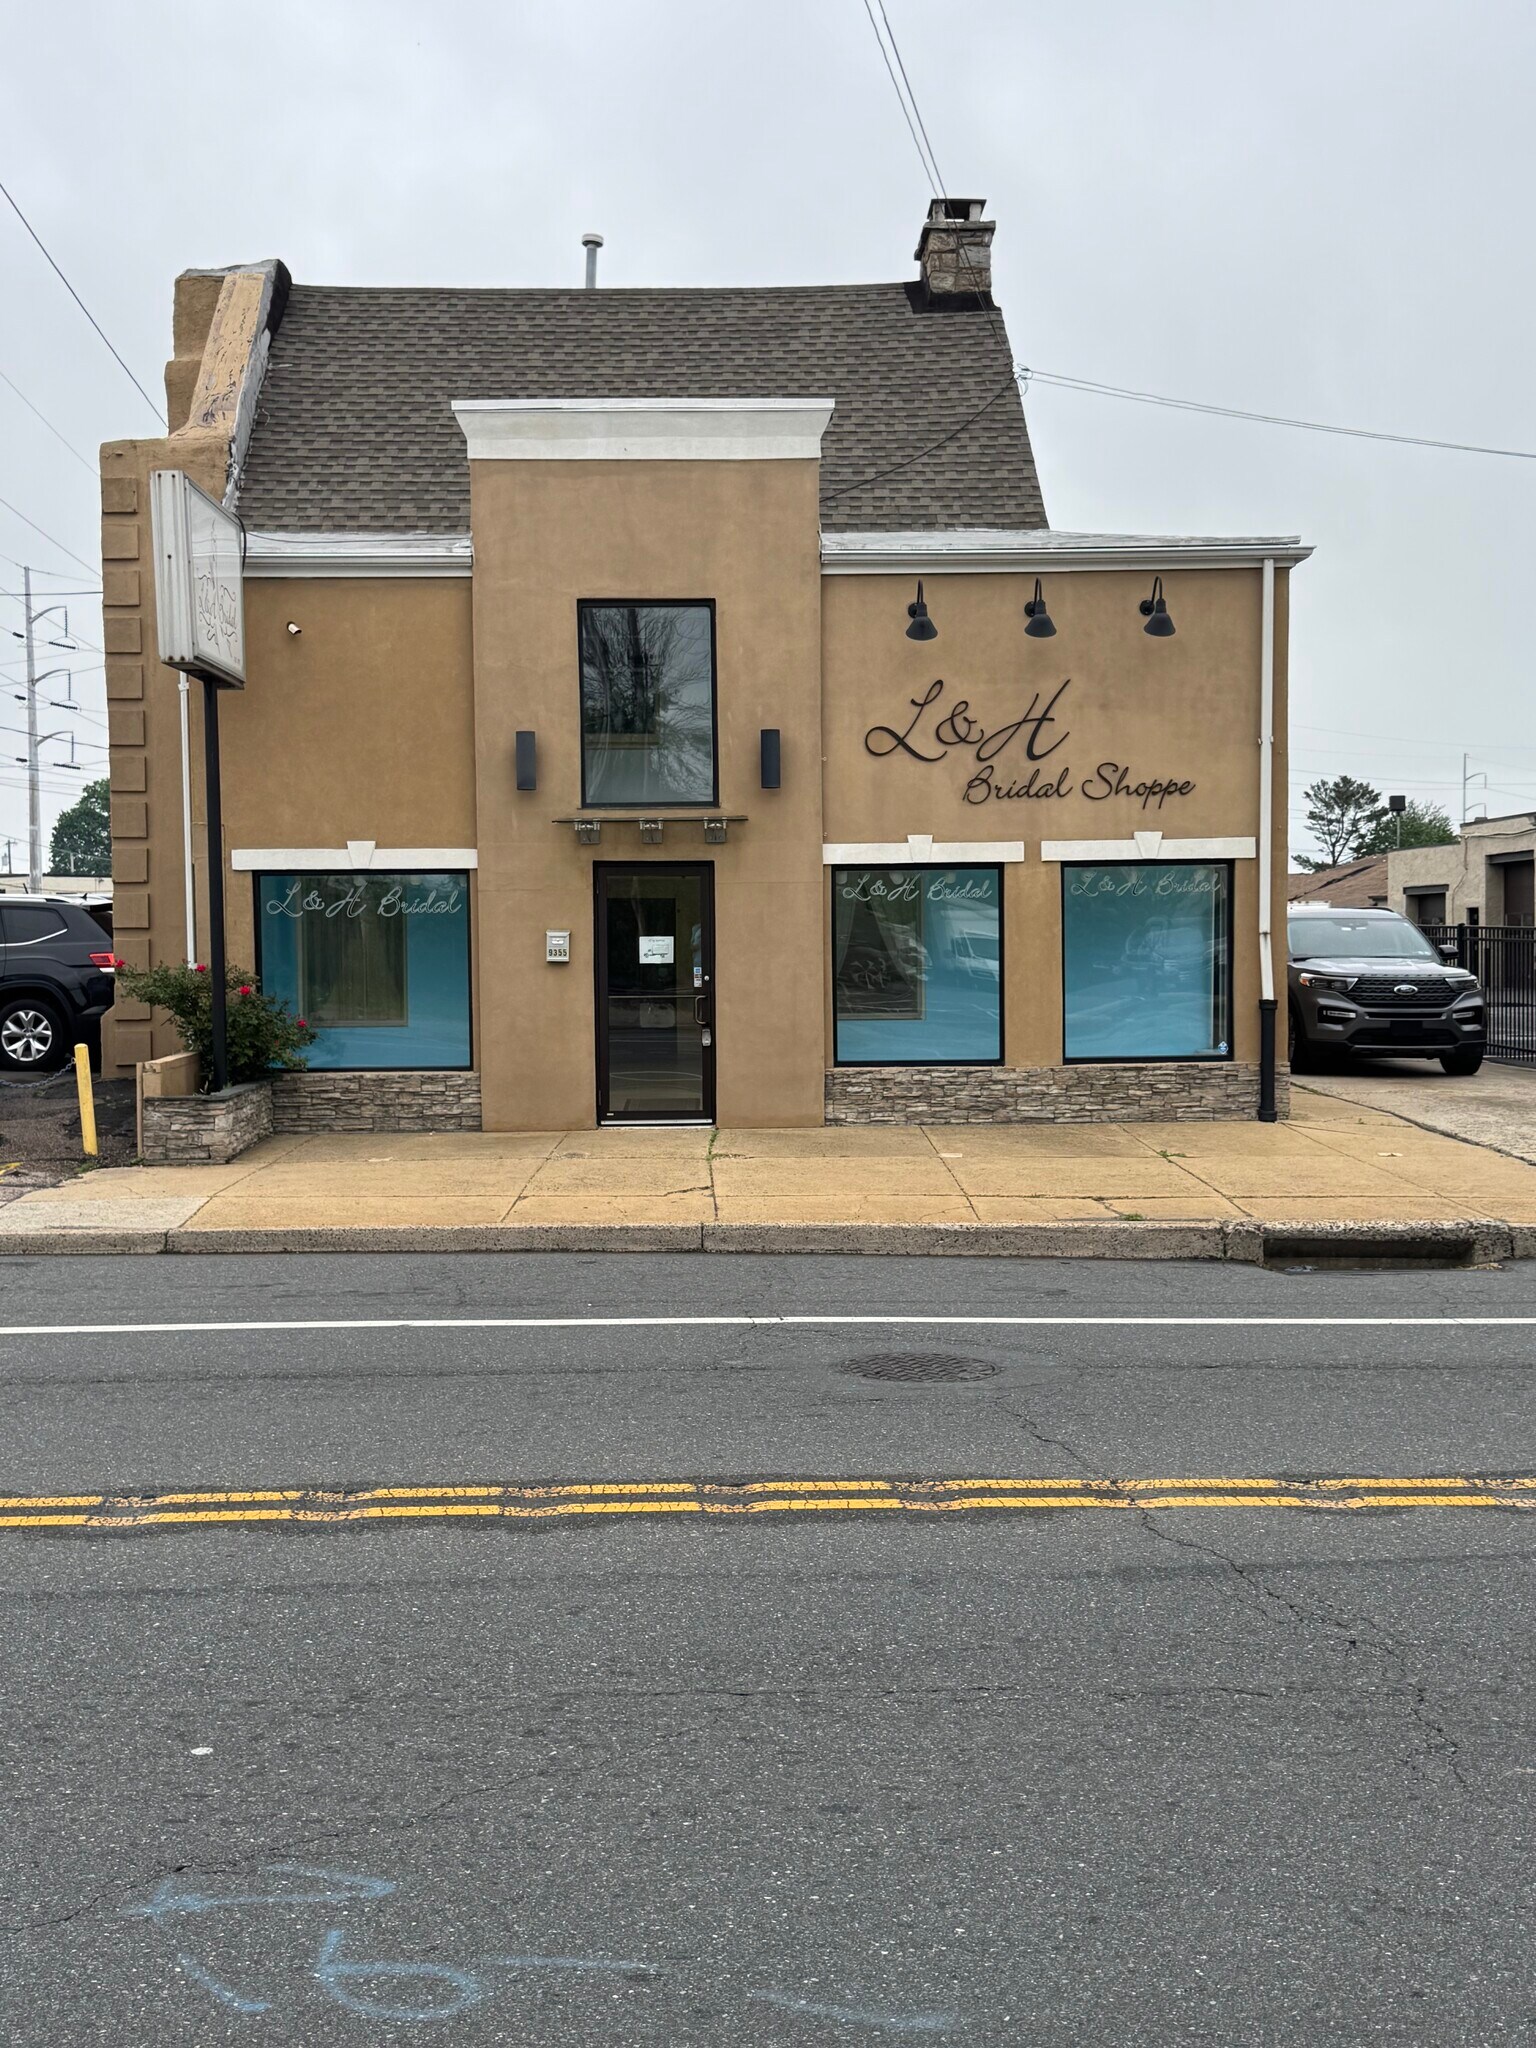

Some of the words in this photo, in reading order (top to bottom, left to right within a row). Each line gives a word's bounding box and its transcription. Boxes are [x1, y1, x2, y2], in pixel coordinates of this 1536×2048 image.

[962, 765, 1074, 804] Bridal
[1082, 762, 1197, 810] Shoppe
[927, 877, 992, 901] Bridal
[1154, 870, 1222, 896] Bridal
[377, 886, 462, 917] Bridal
[548, 948, 568, 957] 9355
